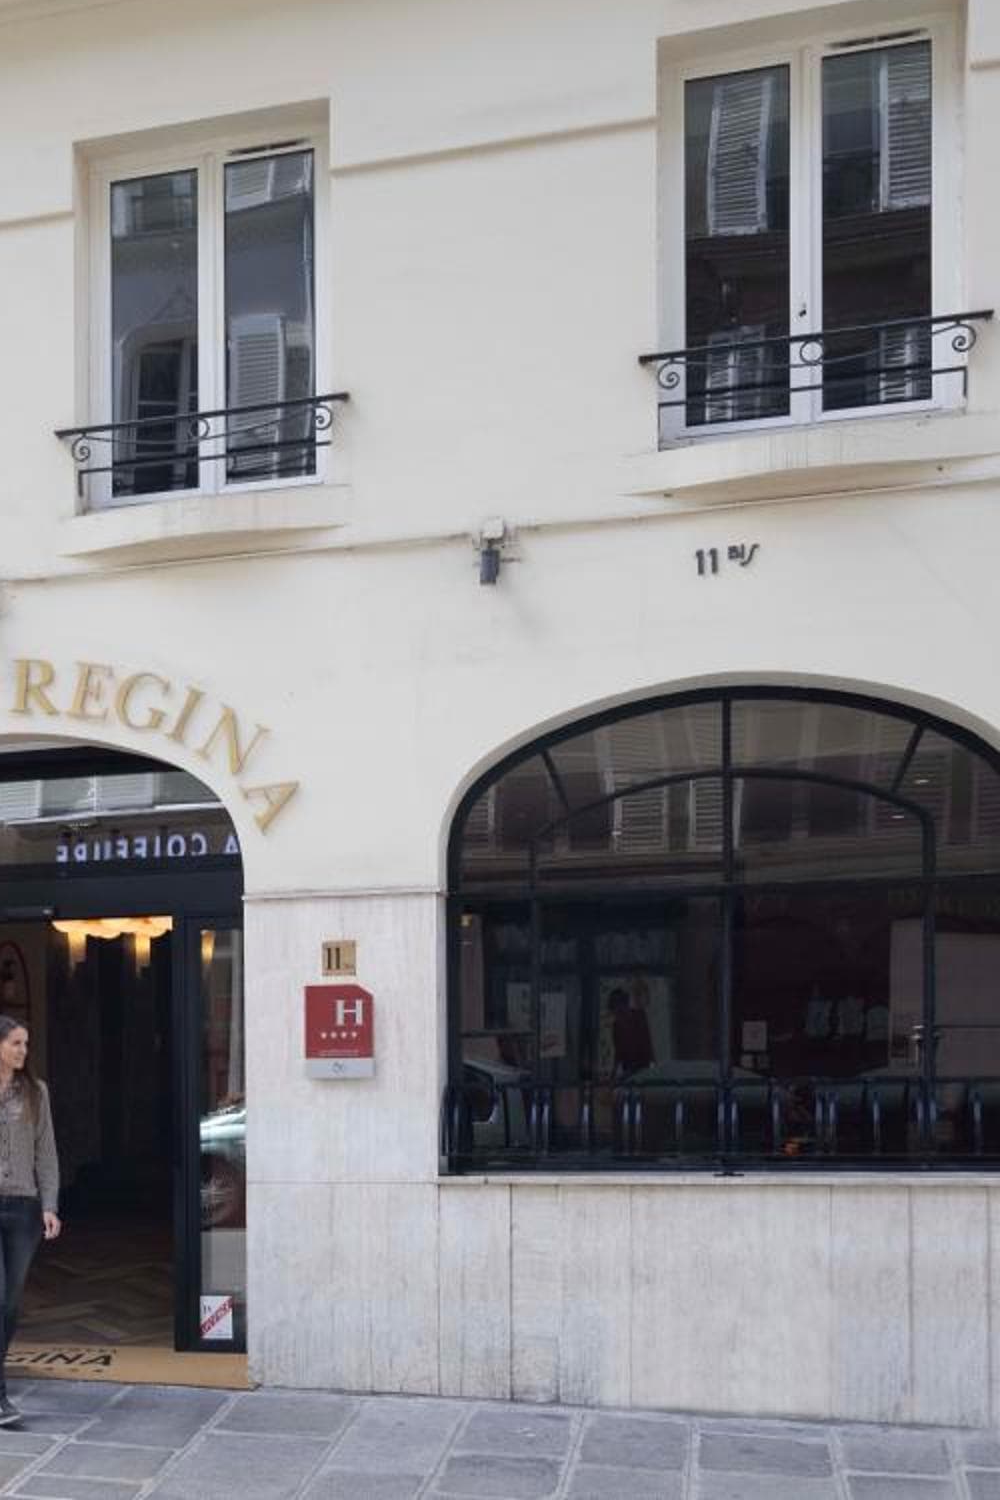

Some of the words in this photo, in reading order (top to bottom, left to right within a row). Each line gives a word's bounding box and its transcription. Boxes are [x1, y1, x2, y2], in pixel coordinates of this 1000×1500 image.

[696, 547, 718, 575] 11
[7, 658, 301, 835] REGINA
[335, 999, 364, 1027] H
